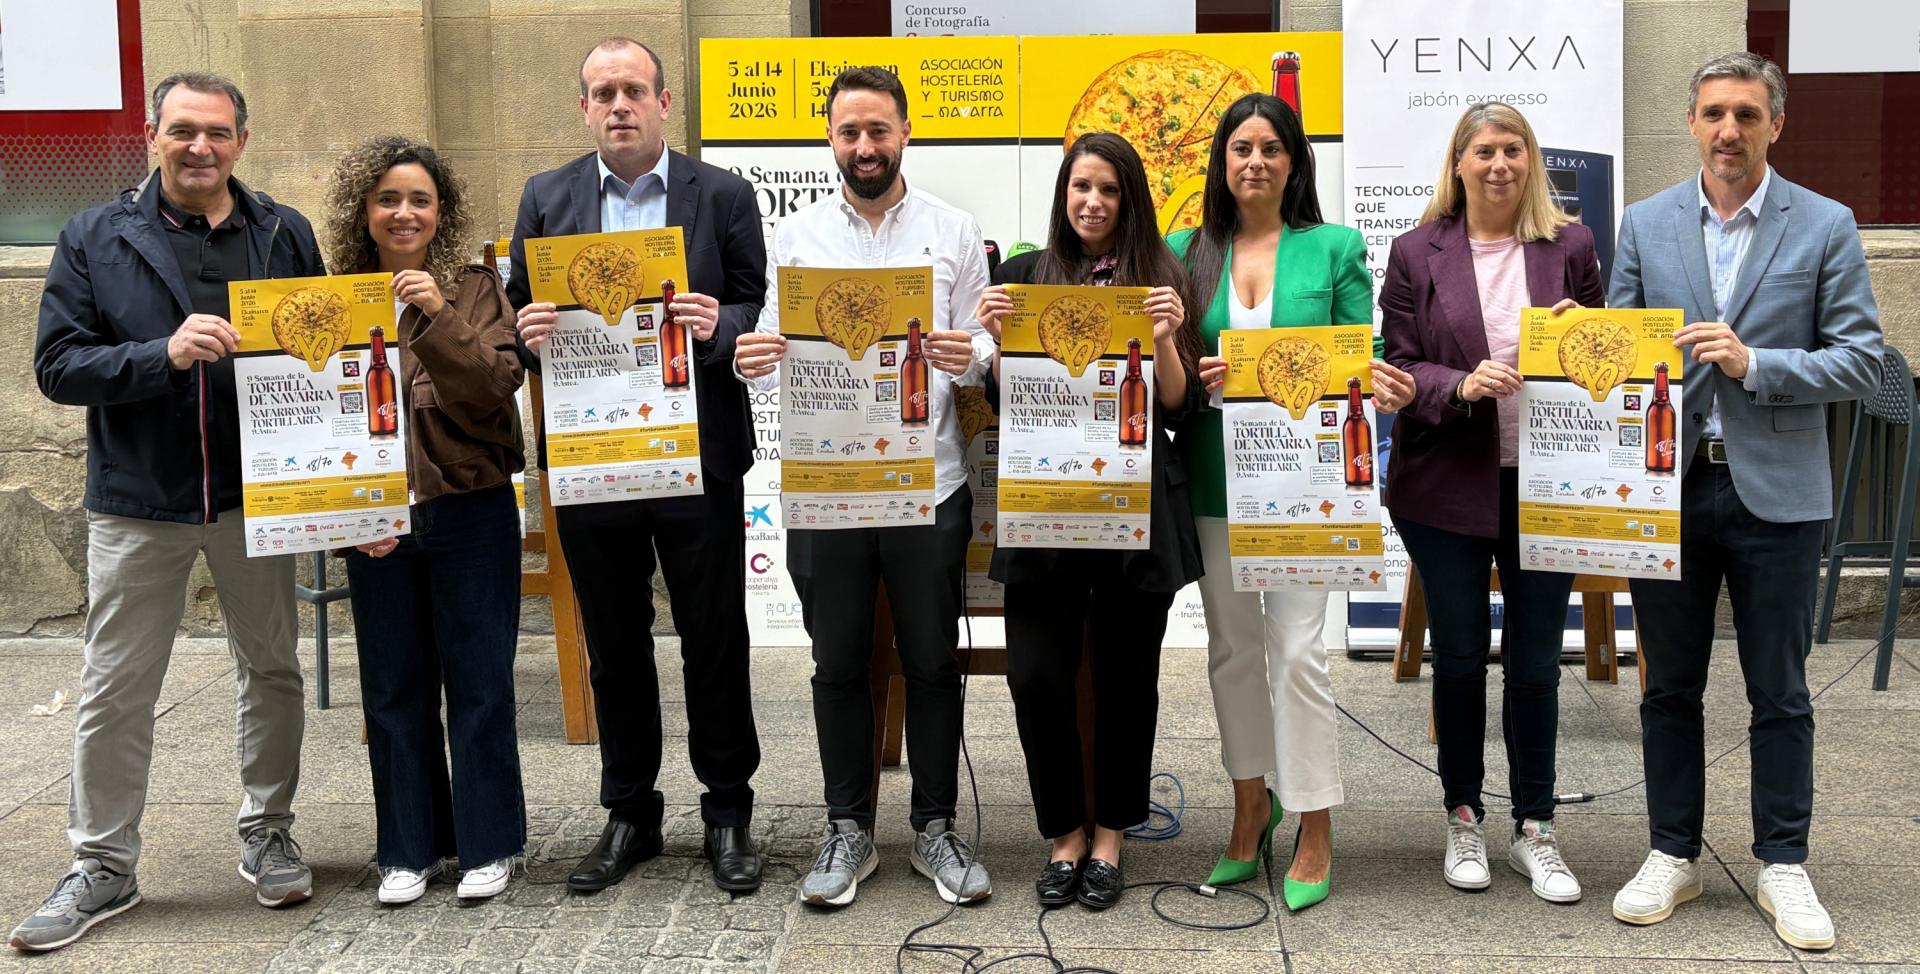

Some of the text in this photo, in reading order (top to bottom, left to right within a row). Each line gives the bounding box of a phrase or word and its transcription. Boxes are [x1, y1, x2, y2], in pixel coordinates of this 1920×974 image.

[905, 5, 967, 16] Concurso
[905, 15, 990, 30] de Fotografía
[1371, 36, 1585, 73] YENXA
[728, 60, 782, 77] 5 al 14
[920, 57, 1003, 71] ASOCIACIÓN
[921, 73, 1004, 86] HOSTELERÍA
[728, 82, 776, 98] Junio
[922, 90, 1004, 102] Y TURISMO
[1408, 91, 1459, 110] jabón
[729, 103, 778, 118] 2026
[750, 166, 830, 184] Semana
[1355, 202, 1386, 213] QUE
[554, 327, 583, 336] Semana
[548, 332, 611, 348] TORTILLA
[550, 342, 630, 359] DE NAVARRA
[551, 357, 618, 372] NAFARROAKO
[789, 365, 852, 377] TORTILLA
[254, 373, 285, 382] Semana
[286, 372, 296, 380] de
[552, 366, 621, 381] TORTILLAREN
[248, 378, 314, 395] TORTILLA
[790, 377, 869, 389] DE NAVARRA
[1009, 382, 1071, 394] TORTILLA
[249, 389, 334, 407] DE NAVARRA
[790, 390, 857, 401] NAFARROAKO
[1010, 394, 1089, 406] DE NAVARRA
[250, 404, 321, 419] NAFARROAKO
[790, 400, 859, 411] TORTILLAREN
[1010, 408, 1076, 418] NAFARROAKO
[1529, 406, 1594, 419] TORTILLA
[250, 414, 324, 429] TORTILLAREN
[1010, 417, 1078, 428] TORTILLAREN
[1239, 419, 1267, 427] Semana
[1530, 417, 1612, 431] DE NAVARRA
[1233, 426, 1294, 439] TORTILLA
[1530, 432, 1599, 443] NAFARROAKO
[1234, 438, 1312, 451] DE NAVARRA
[1529, 441, 1601, 453] TORTILLAREN
[1234, 452, 1300, 463] NAFARROAKO
[1235, 461, 1302, 472] TORTILLAREN
